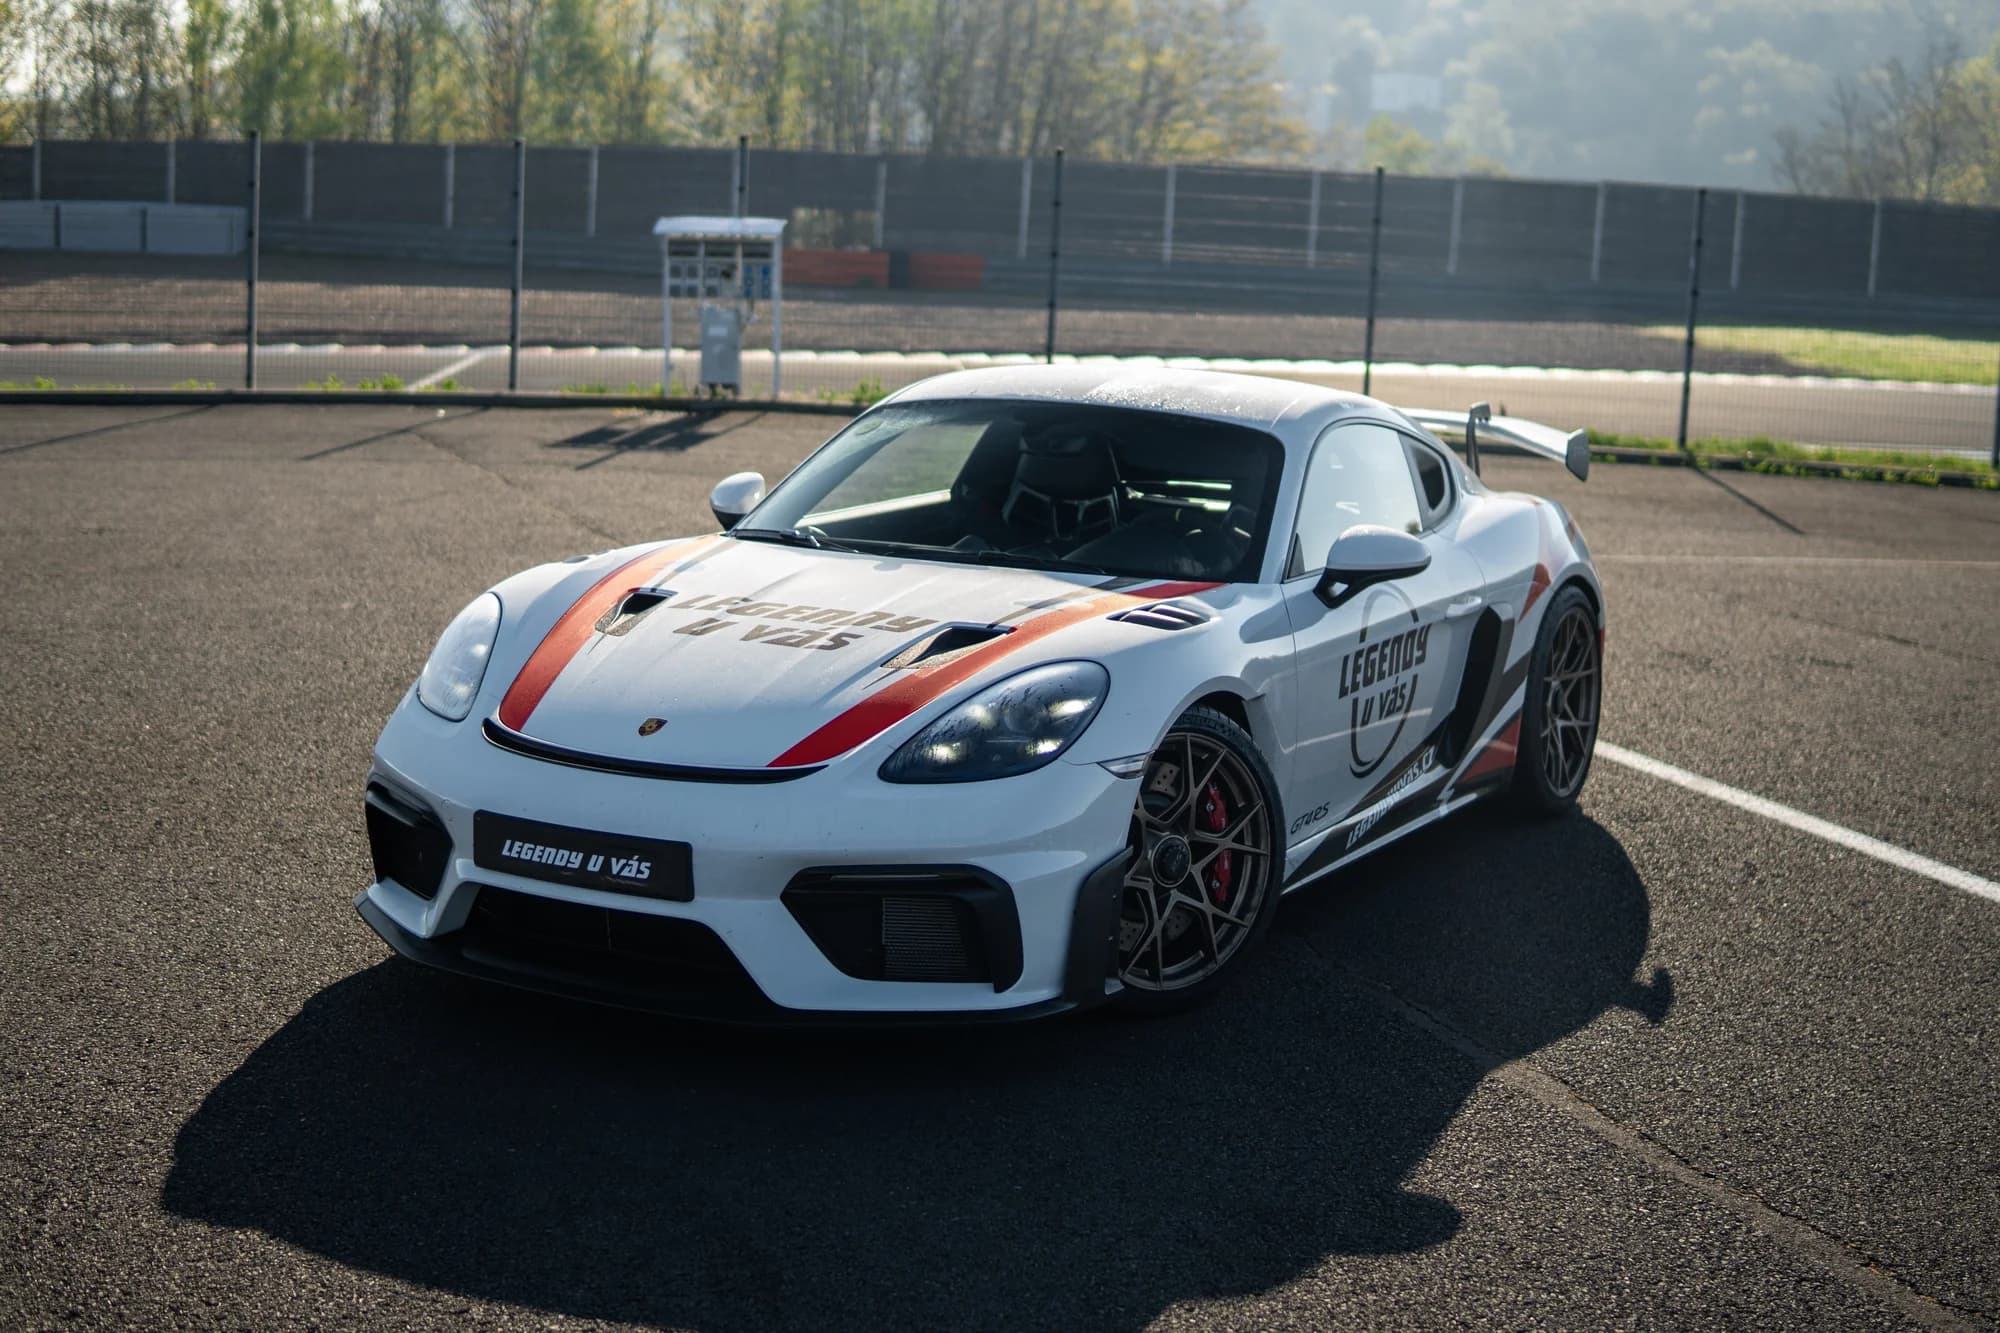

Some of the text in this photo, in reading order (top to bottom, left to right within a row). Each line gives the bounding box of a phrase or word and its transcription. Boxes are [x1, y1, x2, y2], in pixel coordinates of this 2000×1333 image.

[668, 594, 939, 633] LEGENDY
[673, 617, 738, 636] U
[1338, 623, 1433, 700] LEGENDY
[1360, 696, 1375, 728] U
[502, 839, 583, 869] LEGENDY
[587, 855, 604, 872] U
